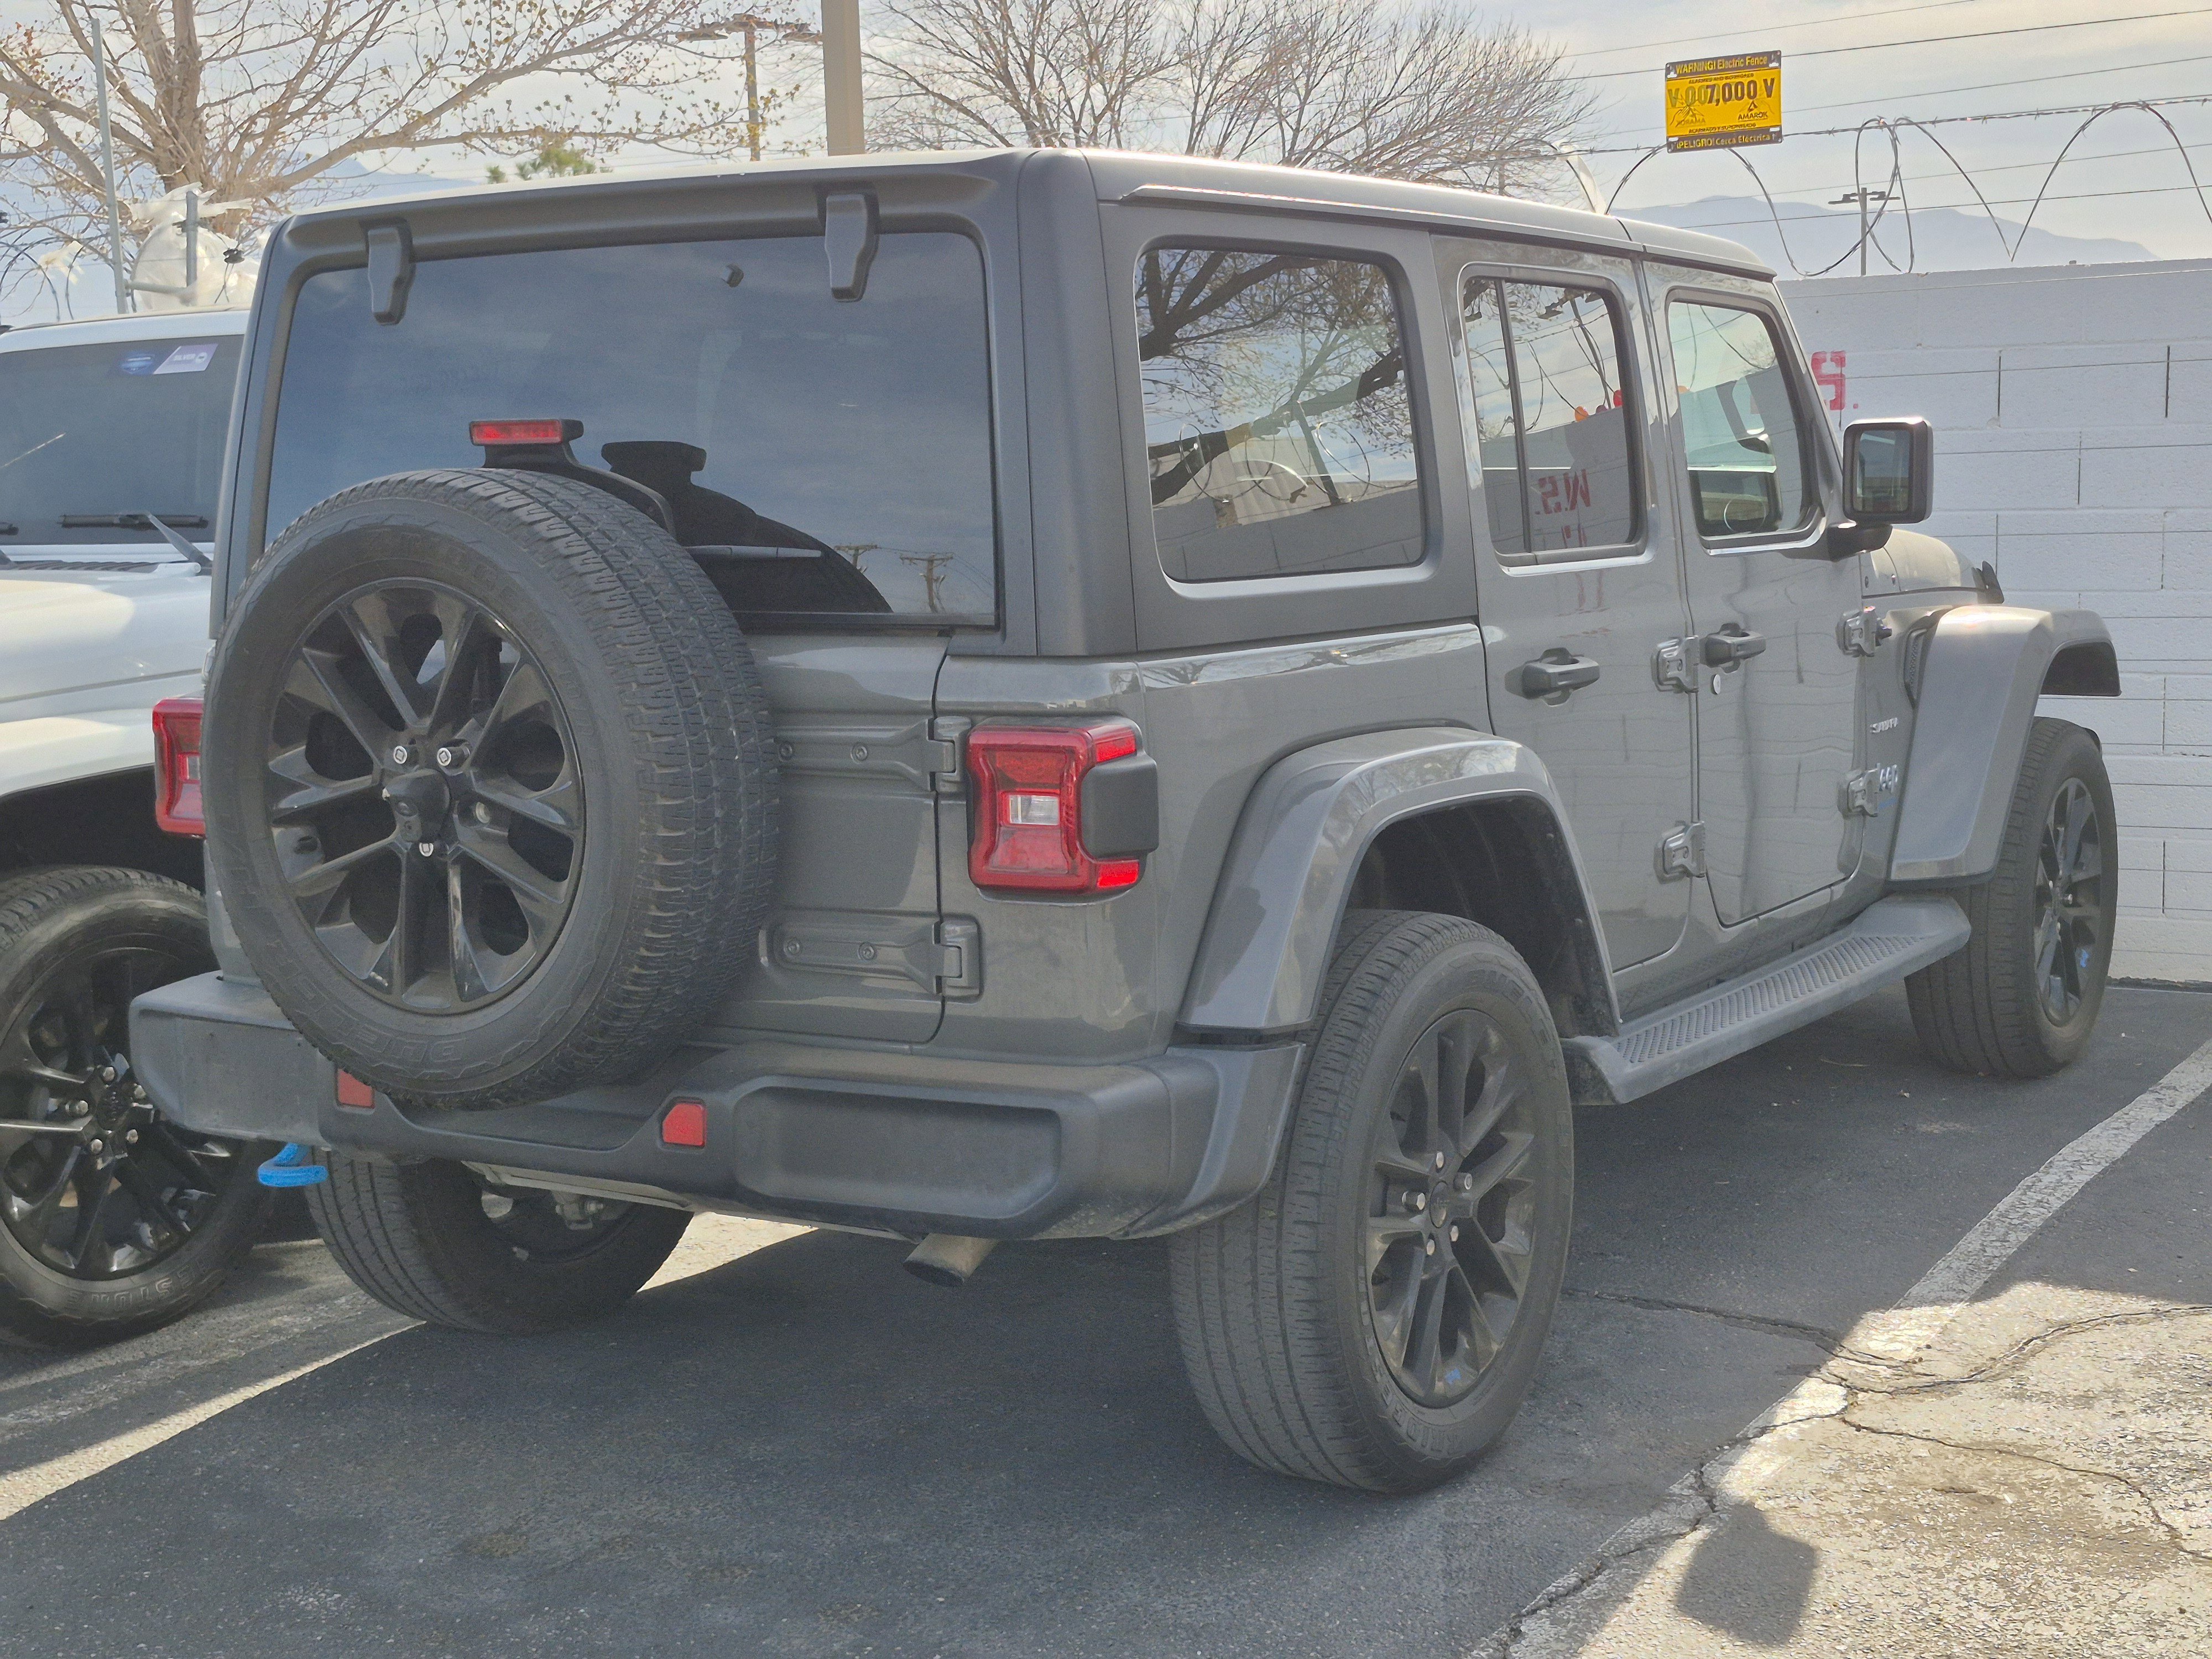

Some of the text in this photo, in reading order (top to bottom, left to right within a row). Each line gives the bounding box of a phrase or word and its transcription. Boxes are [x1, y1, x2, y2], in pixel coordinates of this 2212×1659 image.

[1676, 56, 1767, 74] WARNING! Electric Fence
[1706, 77, 1776, 106] 7,000 V
[1738, 112, 1768, 121] AMAROK
[1715, 137, 1736, 145] Cerca
